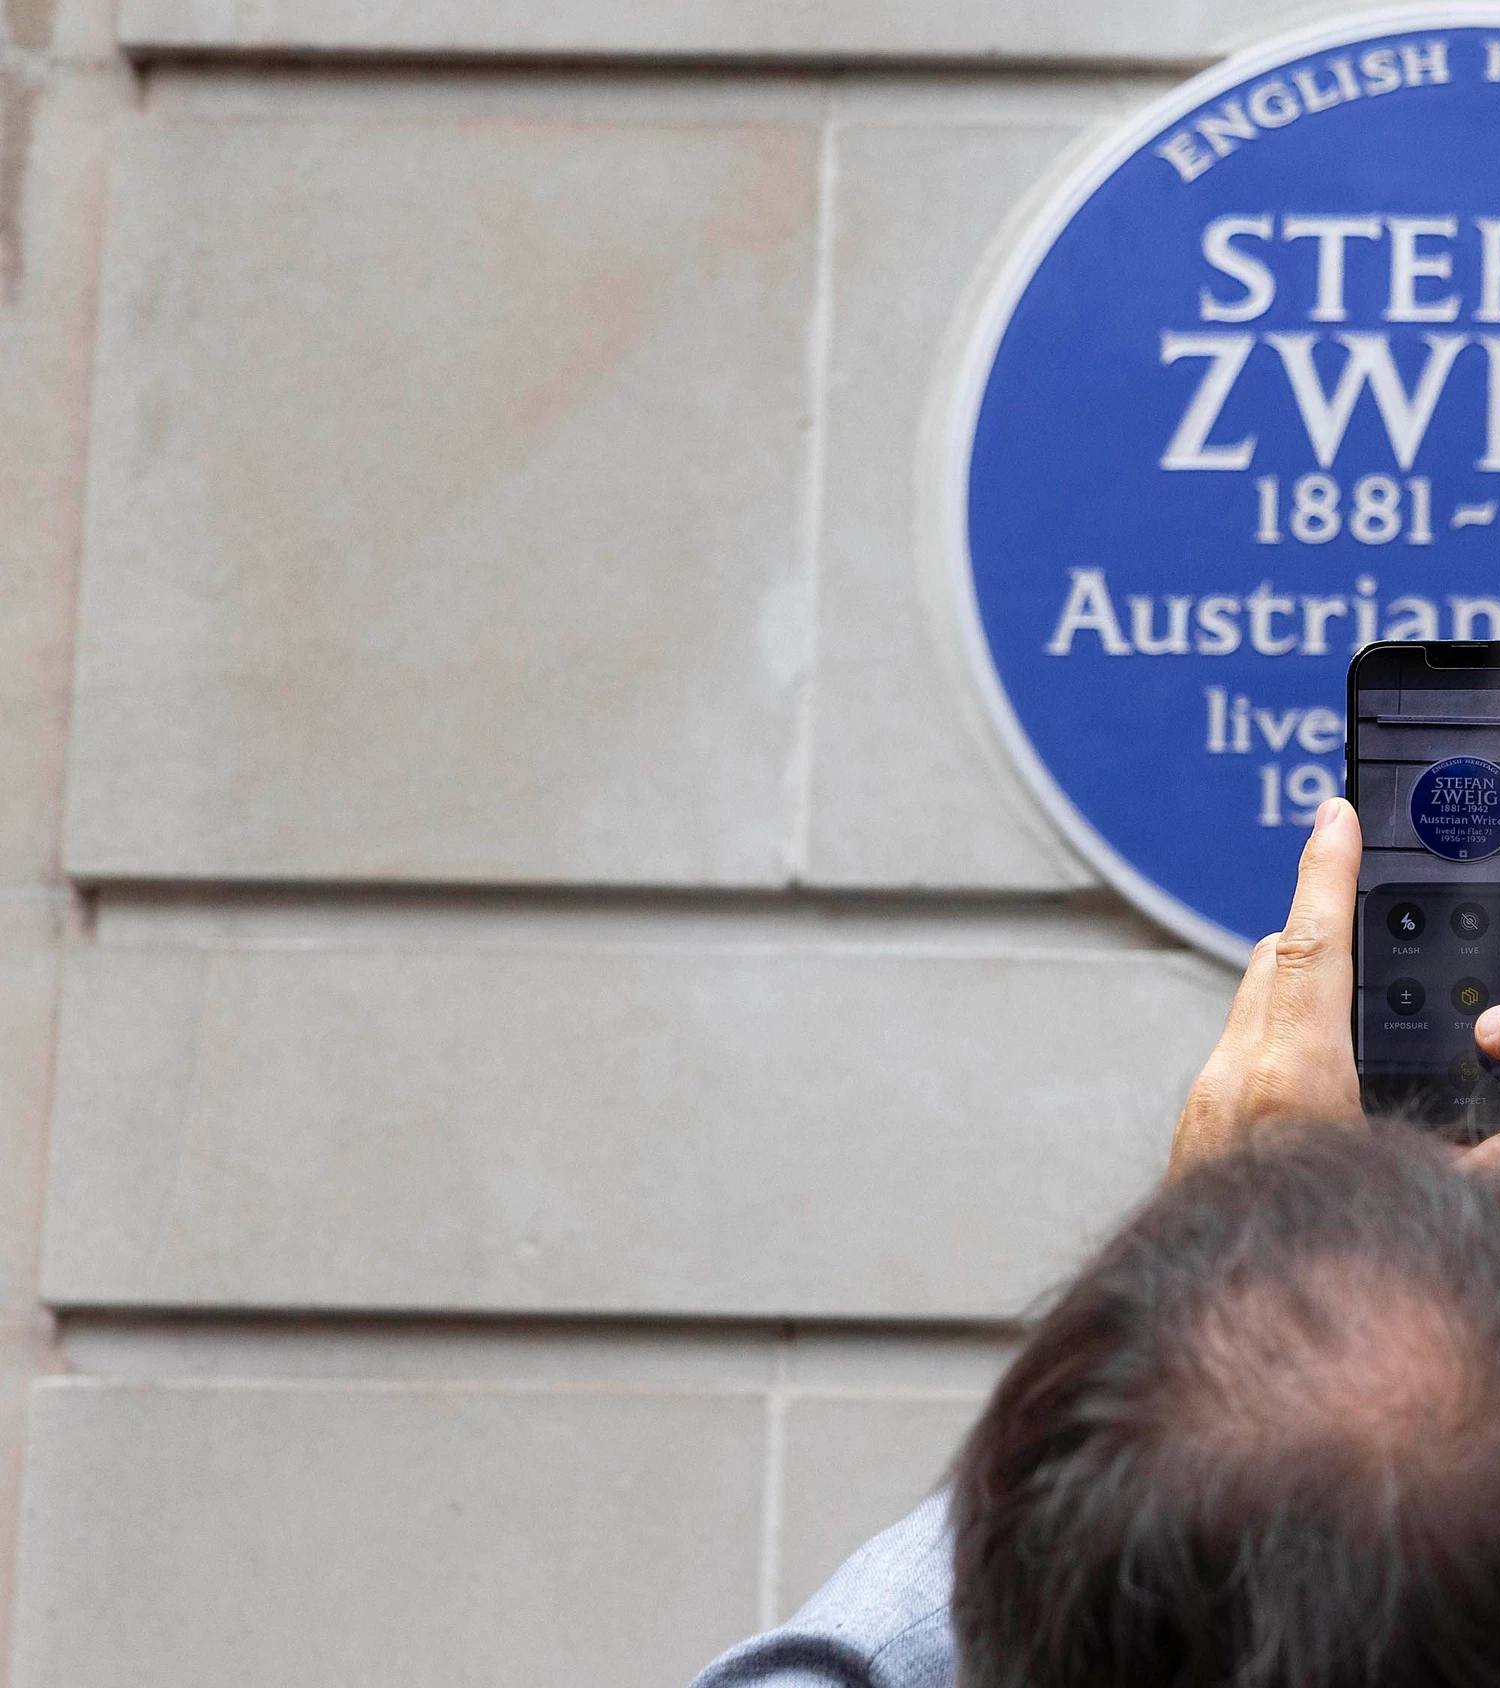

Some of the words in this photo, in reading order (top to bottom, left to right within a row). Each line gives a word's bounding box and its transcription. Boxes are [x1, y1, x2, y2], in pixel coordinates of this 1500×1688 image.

[1158, 41, 1451, 185] ENGLISH
[1204, 685, 1344, 754] live
[1435, 777, 1494, 789] STEFAN
[1431, 790, 1498, 805] ZWEIG
[1419, 814, 1469, 825] Austrian
[1435, 827, 1456, 835] lived
[1484, 828, 1493, 836] 71
[1392, 946, 1420, 955] FLASH
[1460, 946, 1479, 955] LIVE
[1384, 1022, 1429, 1030] EXPOSURE
[1454, 1022, 1475, 1030] STYL
[1453, 1097, 1487, 1105] ASPECT
